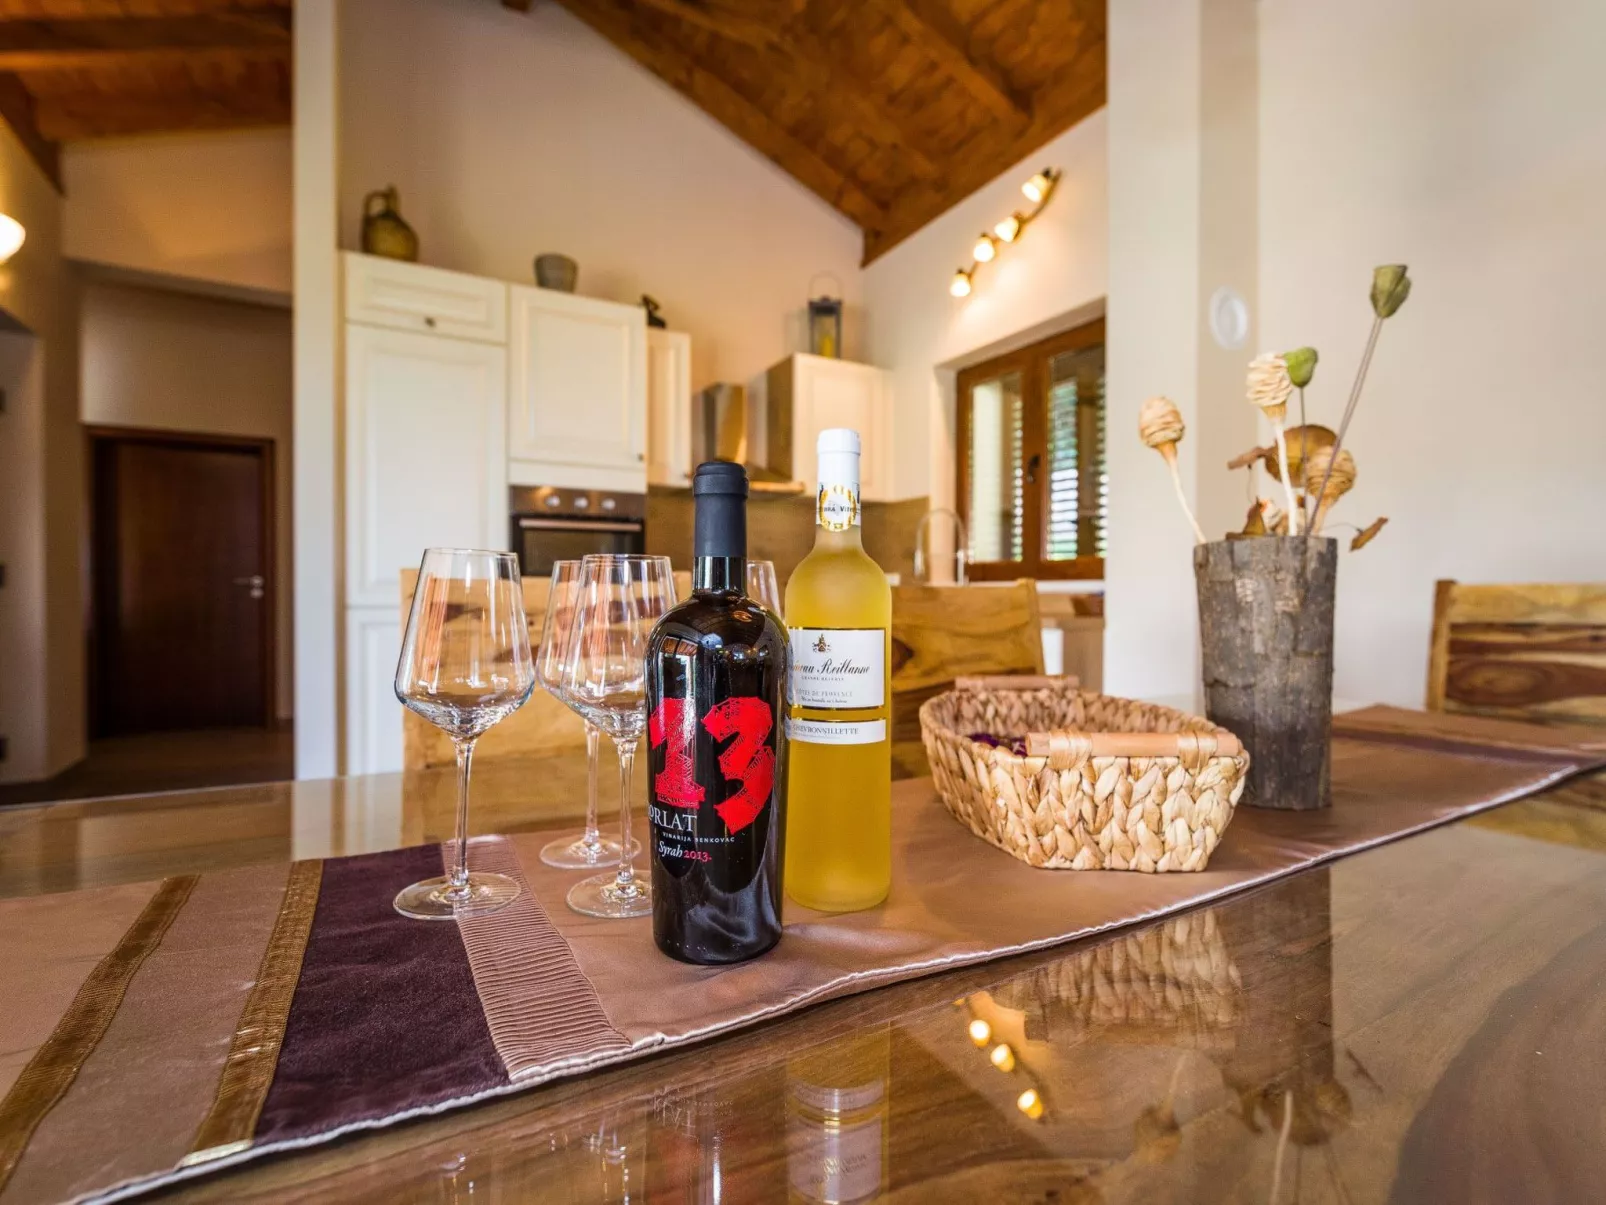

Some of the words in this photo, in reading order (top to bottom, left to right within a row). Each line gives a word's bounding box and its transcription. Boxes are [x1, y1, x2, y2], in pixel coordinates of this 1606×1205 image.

[650, 697, 776, 835] 13
[647, 804, 698, 832] ORLAT
[662, 831, 692, 842] VINARIJA
[658, 840, 683, 858] Syrah
